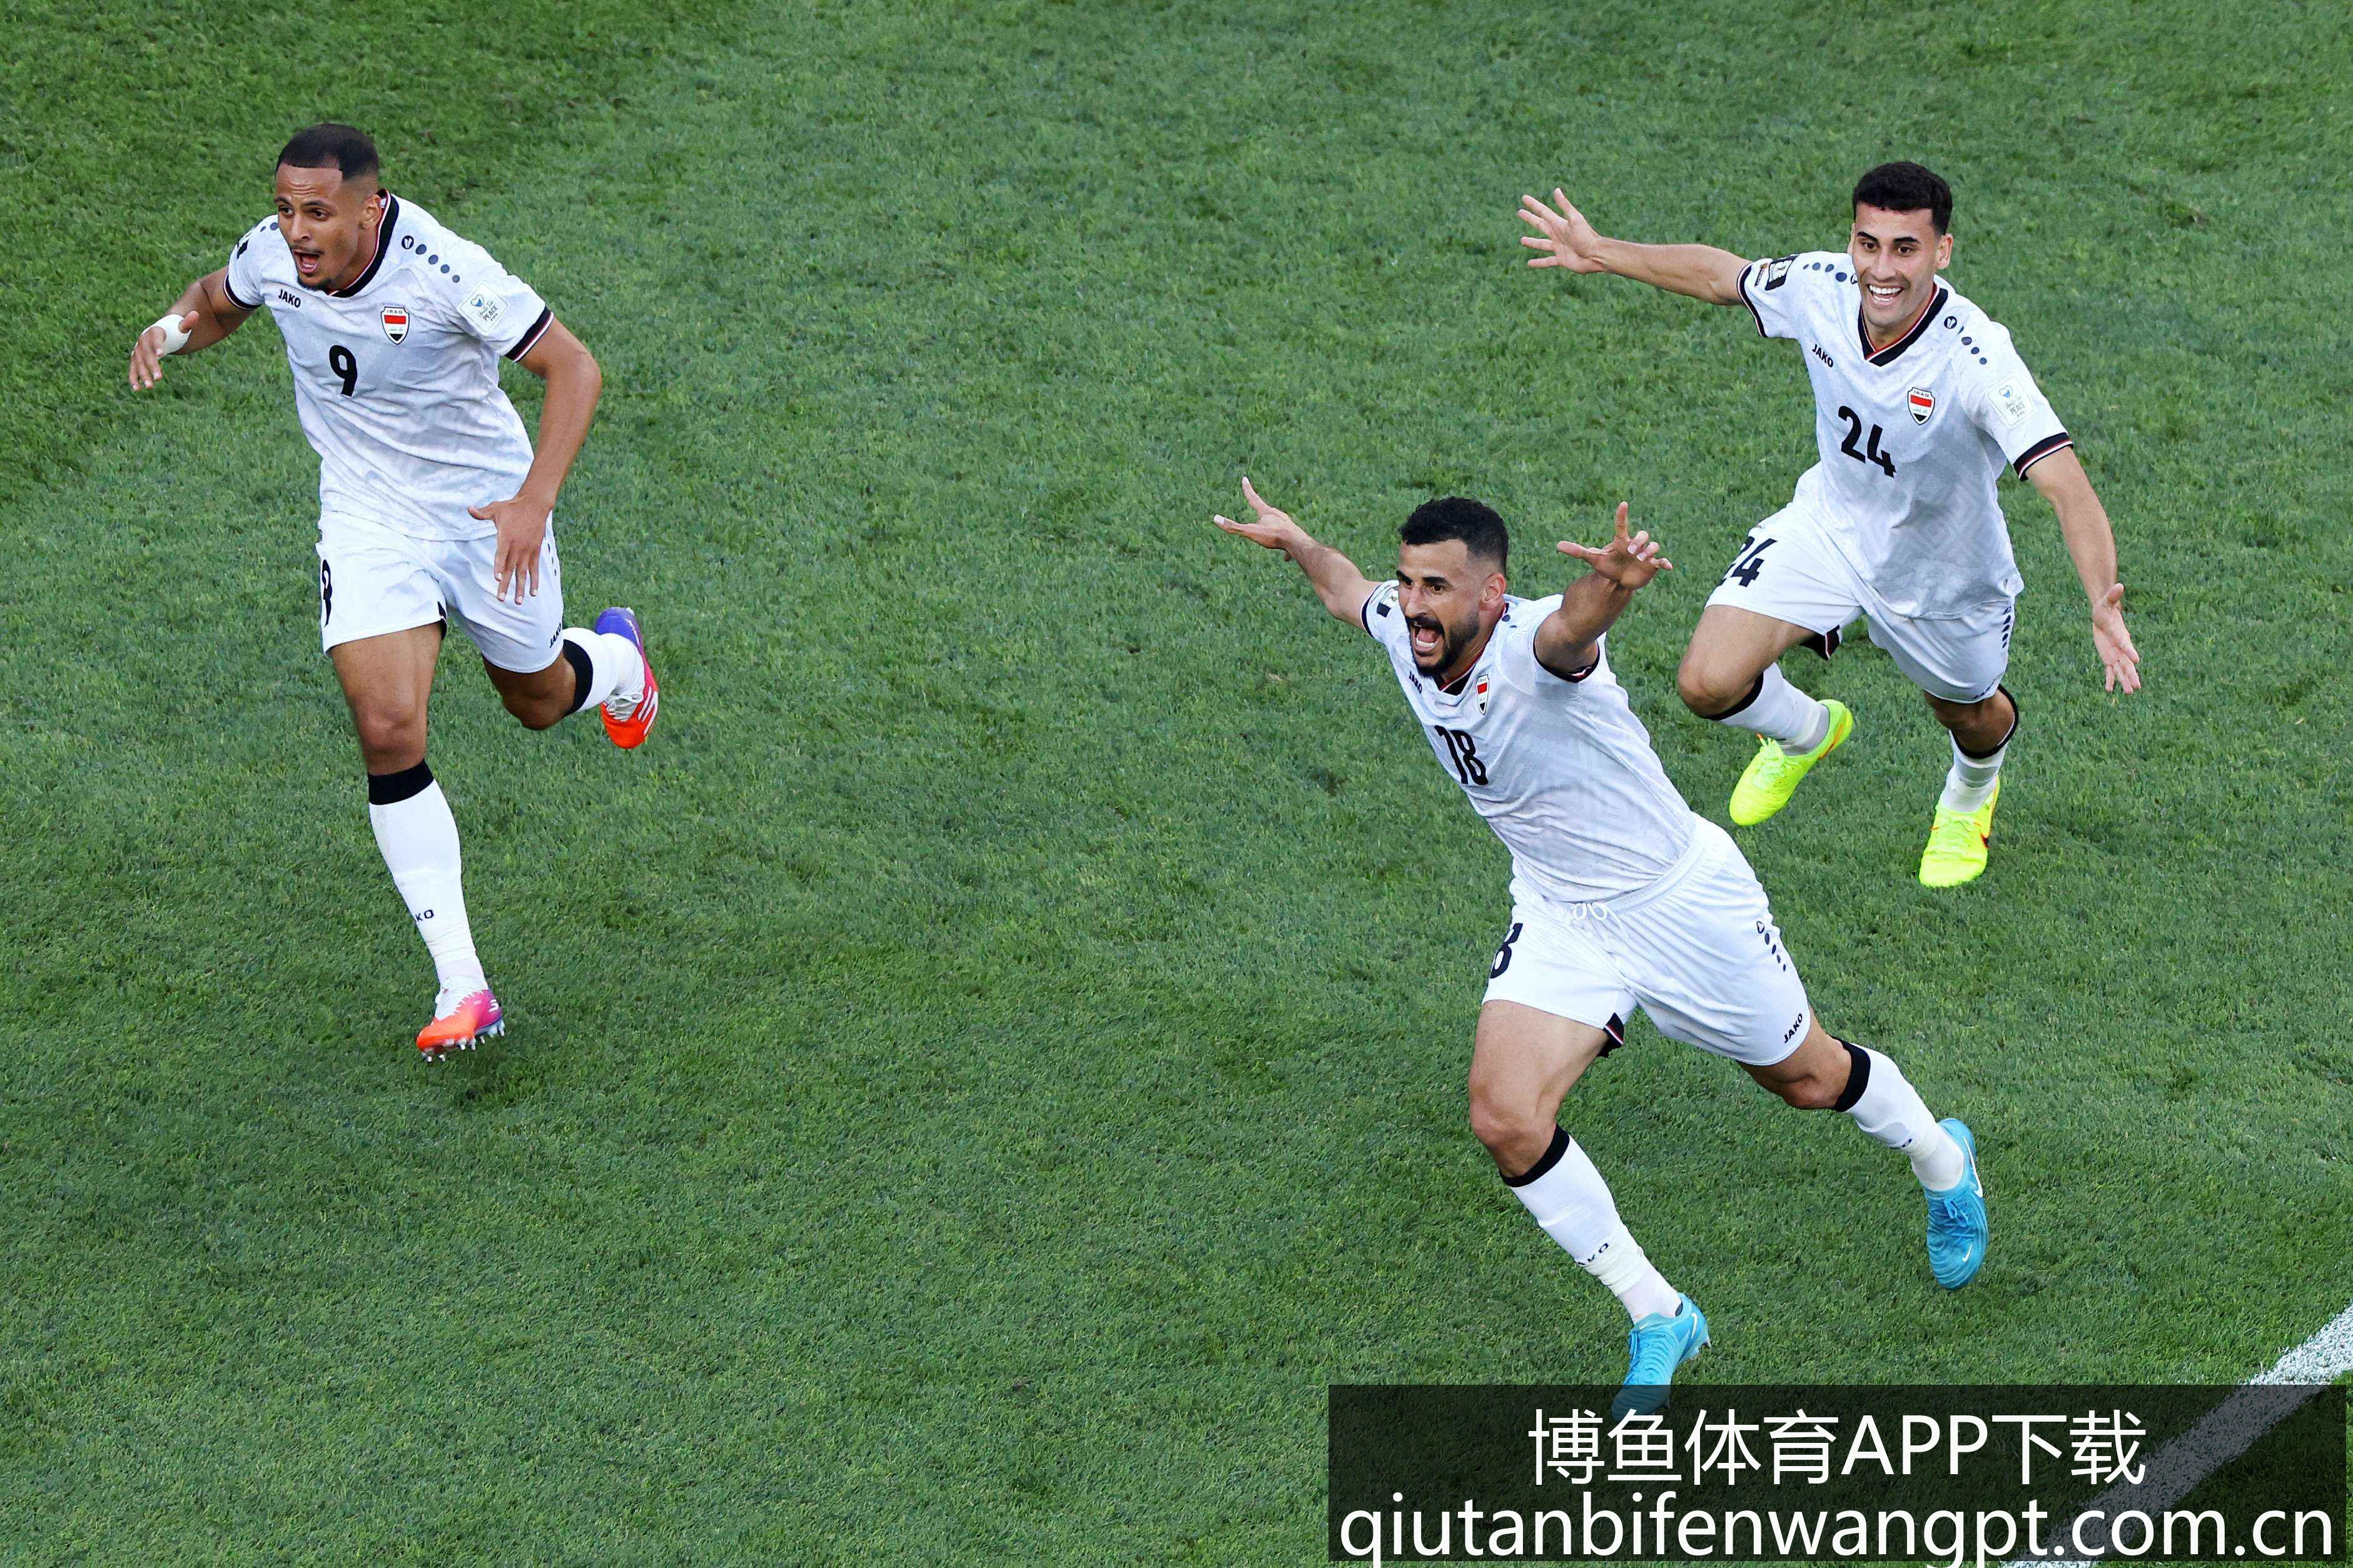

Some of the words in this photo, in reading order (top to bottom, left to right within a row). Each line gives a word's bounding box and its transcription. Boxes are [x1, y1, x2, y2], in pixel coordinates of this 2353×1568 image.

[278, 289, 301, 308] JAKO
[330, 345, 358, 397] 9
[1812, 343, 1833, 367] JAKO
[1838, 405, 1896, 478] 24
[1434, 725, 1489, 786] 18
[1784, 1013, 1803, 1044] JAKO
